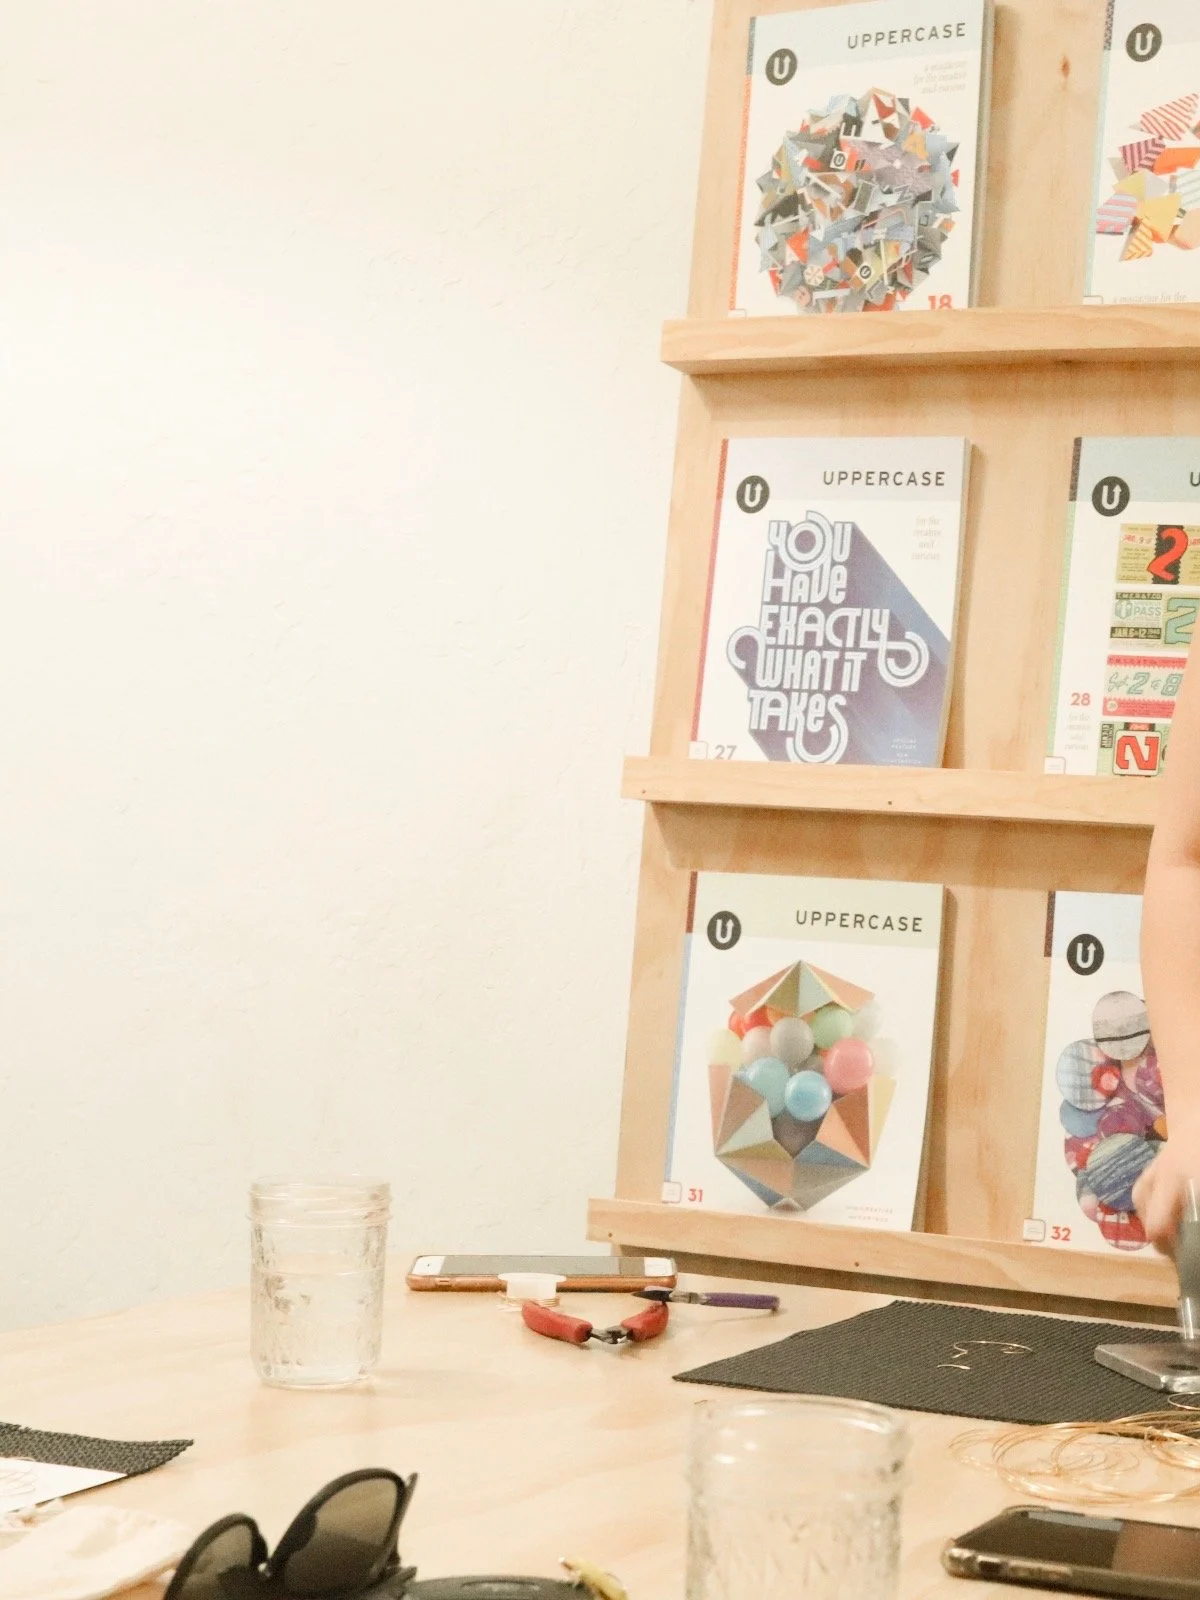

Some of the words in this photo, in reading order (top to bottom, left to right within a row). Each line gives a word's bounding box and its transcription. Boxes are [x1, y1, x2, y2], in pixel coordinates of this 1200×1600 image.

[847, 22, 965, 49] UPPERCASE
[823, 470, 945, 486] UPPERCASE
[1146, 527, 1188, 582] 2
[1070, 692, 1091, 706] 28
[715, 745, 737, 760] 27
[796, 910, 922, 932] UPPERCASE
[688, 1188, 703, 1202] 31
[1051, 1226, 1071, 1241] 32
